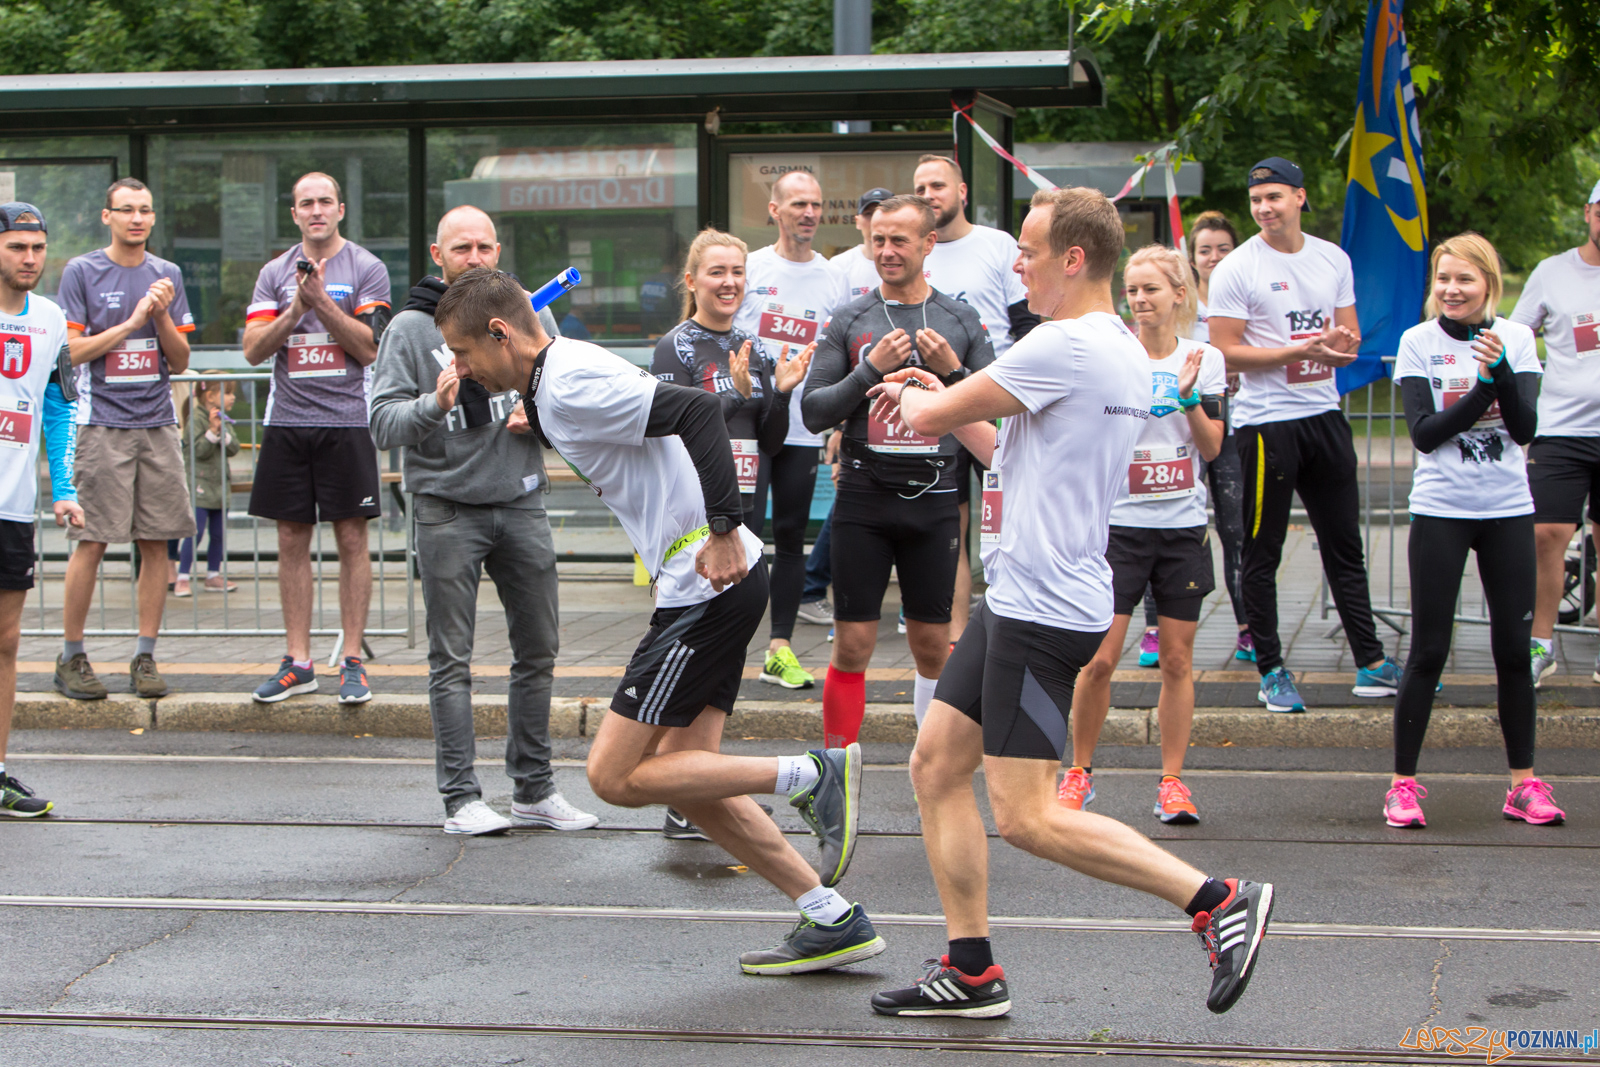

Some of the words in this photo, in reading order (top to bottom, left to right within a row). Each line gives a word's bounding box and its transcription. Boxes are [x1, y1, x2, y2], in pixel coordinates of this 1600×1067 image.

[759, 166, 813, 175] GARMIN
[770, 316, 807, 338] 34/4
[1285, 310, 1324, 332] 1956
[117, 353, 152, 370] 35/4
[297, 348, 335, 365] 36/4
[1141, 464, 1185, 485] 28/4
